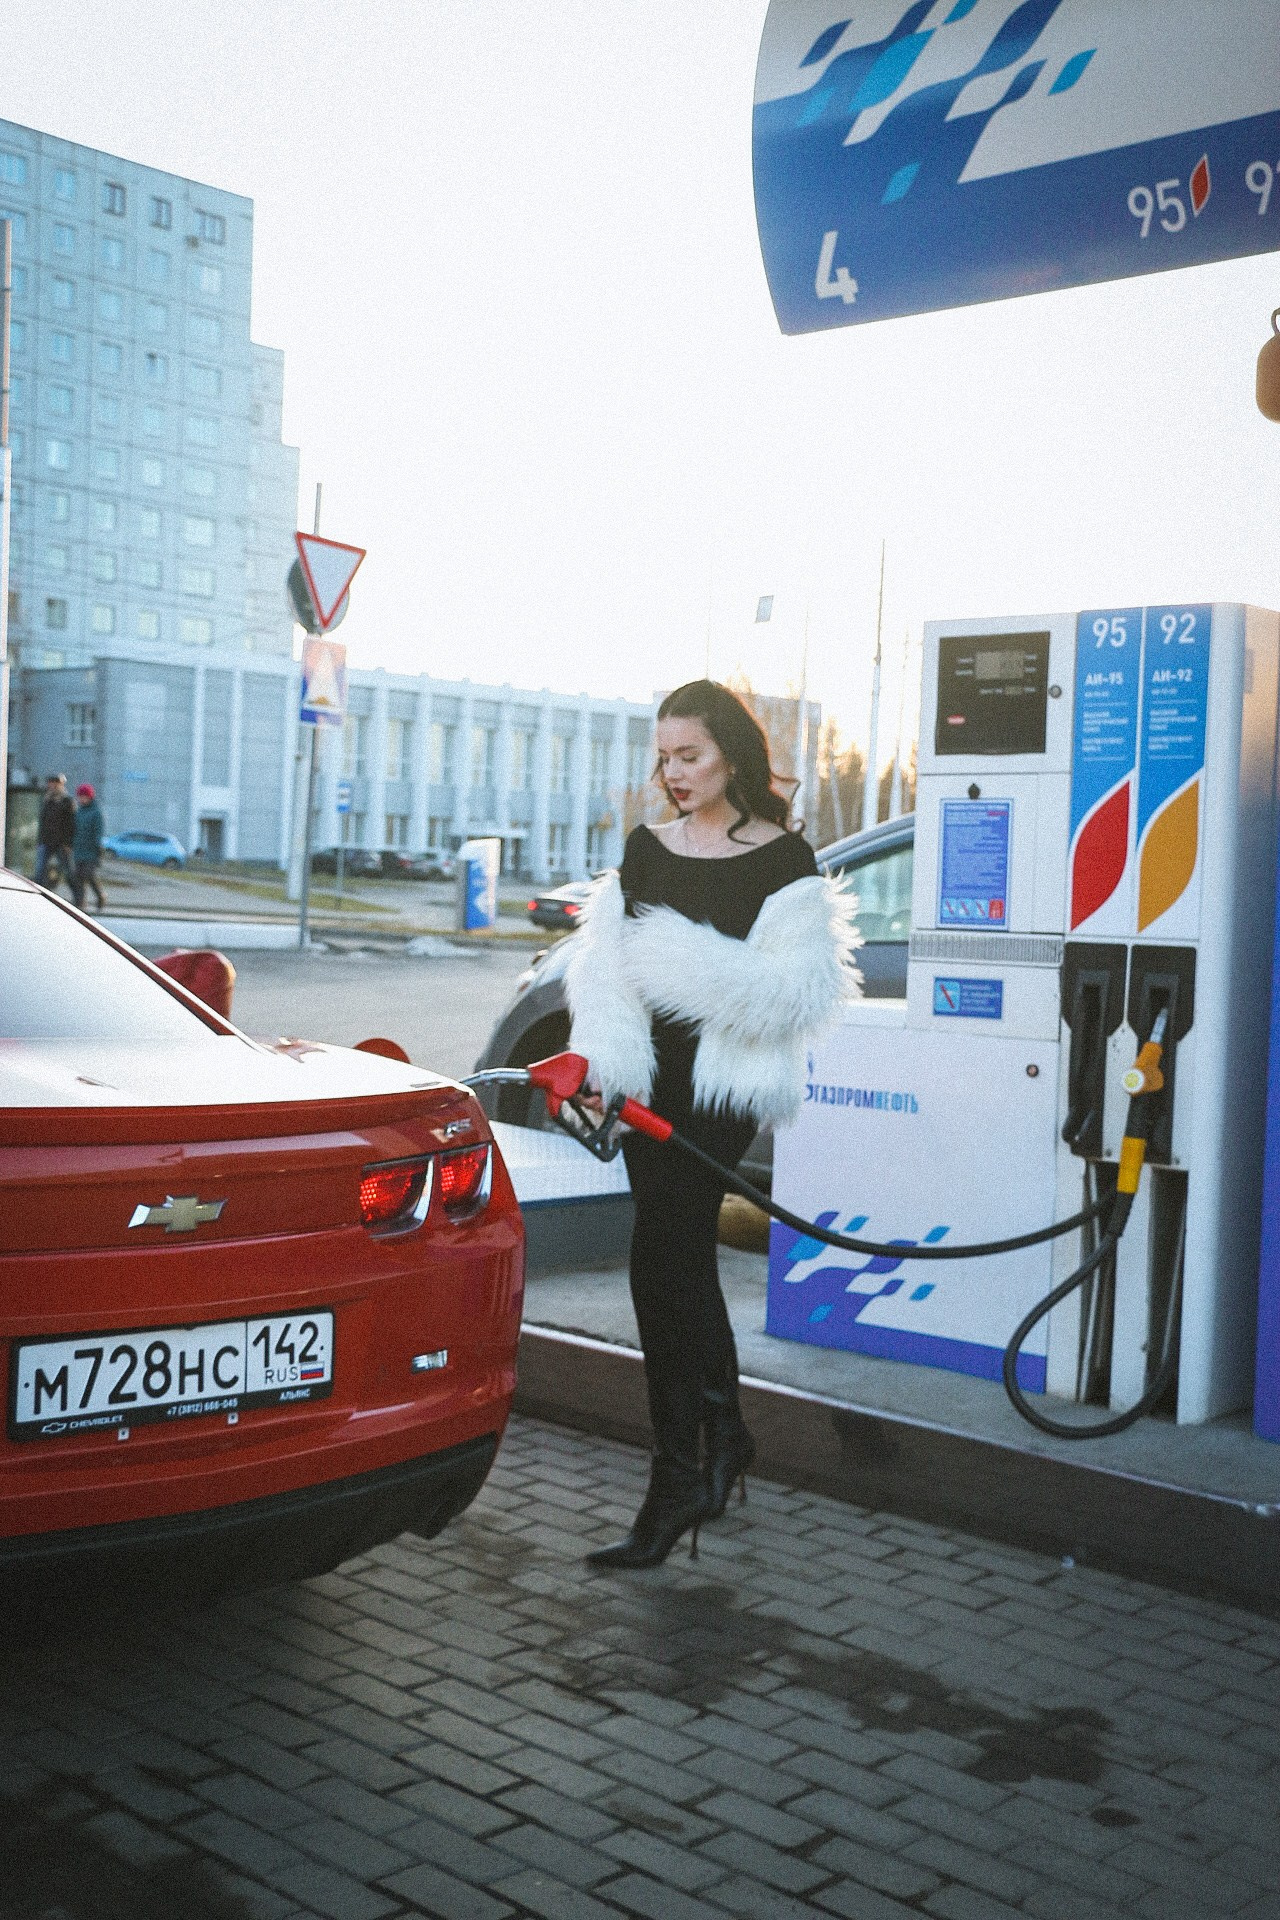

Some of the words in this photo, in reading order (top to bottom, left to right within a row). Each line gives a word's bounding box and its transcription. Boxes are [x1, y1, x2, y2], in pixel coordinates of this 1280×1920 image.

[1127, 178, 1186, 238] 95
[1245, 160, 1280, 215] 9
[814, 230, 859, 304] 4
[1092, 616, 1127, 648] 95
[1160, 612, 1197, 644] 92
[252, 1320, 319, 1369] 142
[264, 1366, 299, 1385] RUS
